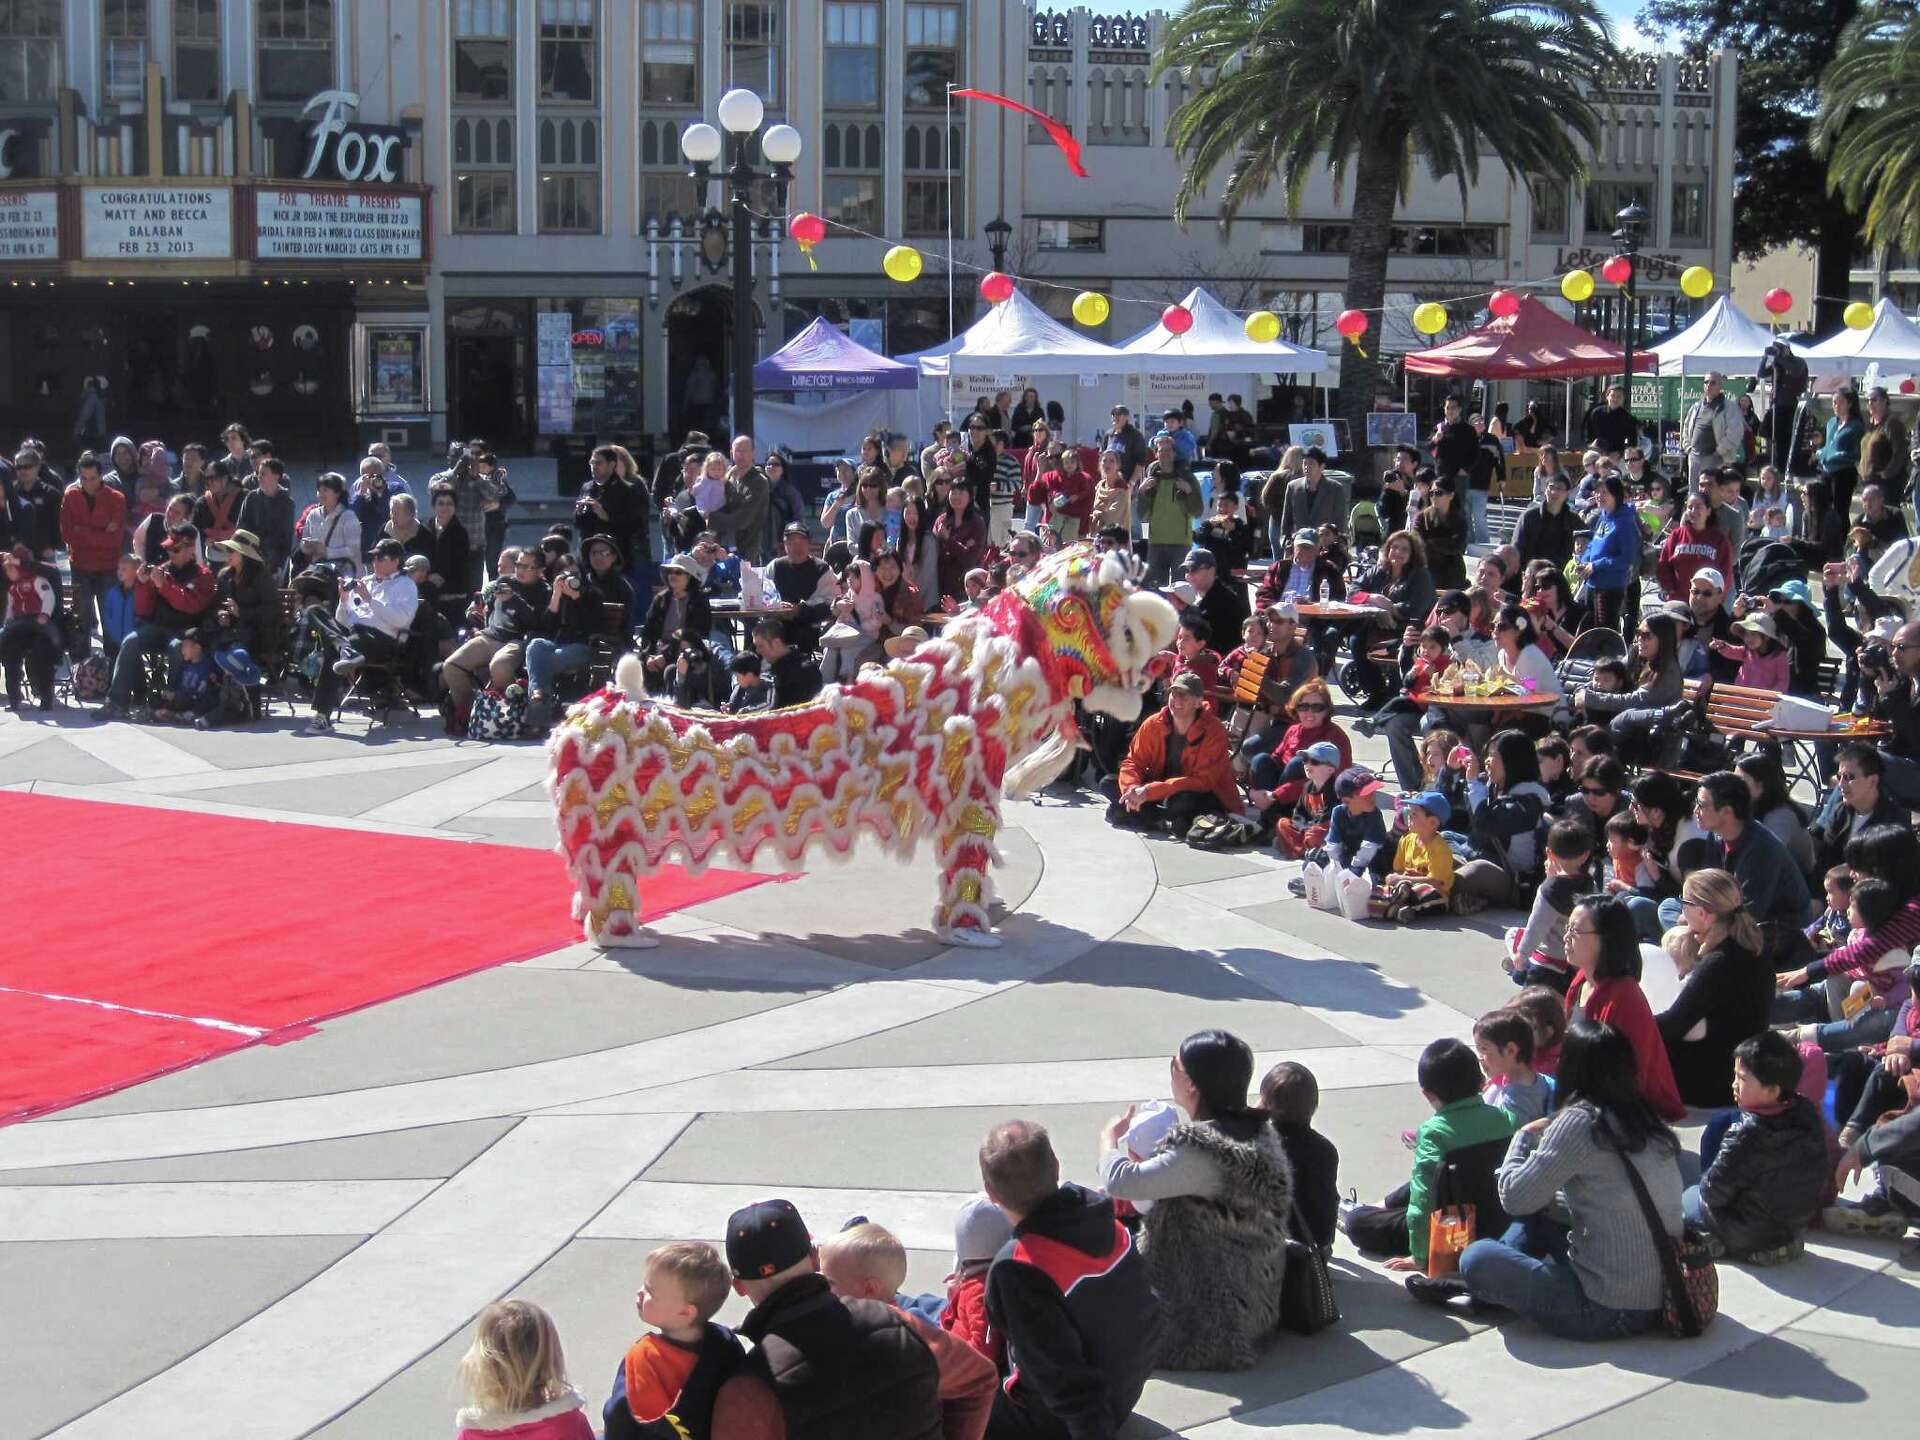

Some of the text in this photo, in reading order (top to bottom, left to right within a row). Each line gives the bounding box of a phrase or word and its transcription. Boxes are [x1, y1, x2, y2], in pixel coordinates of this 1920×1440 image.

[101, 193, 212, 204] CONGRATULATIONS
[278, 192, 400, 209] FOX THEATRE PRESENTS
[105, 210, 207, 220] MATT AND BECCA
[304, 211, 323, 223] DORA
[325, 212, 338, 223] THE
[340, 212, 374, 223] EXPLORER
[377, 213, 389, 224] FEB
[129, 226, 183, 237] BALABAN
[257, 226, 284, 238] BRIDAL
[287, 227, 303, 238] FAIR
[304, 227, 317, 238] FEB
[318, 227, 327, 238] 24
[329, 227, 352, 239] WORLD
[353, 228, 376, 239] CLASS
[376, 228, 401, 239] BOXING
[119, 242, 194, 253] FEB 23 2013
[272, 241, 302, 253] TAINTED
[303, 242, 323, 253] LOVE
[324, 243, 348, 254] MARCH
[360, 243, 378, 254] CATS
[380, 244, 393, 254] APR
[571, 332, 603, 344] OPEN
[968, 384, 1026, 393] International
[1631, 385, 1665, 395] WHOLE
[1630, 394, 1658, 403] FOOD
[1675, 543, 1717, 560] STANFORD
